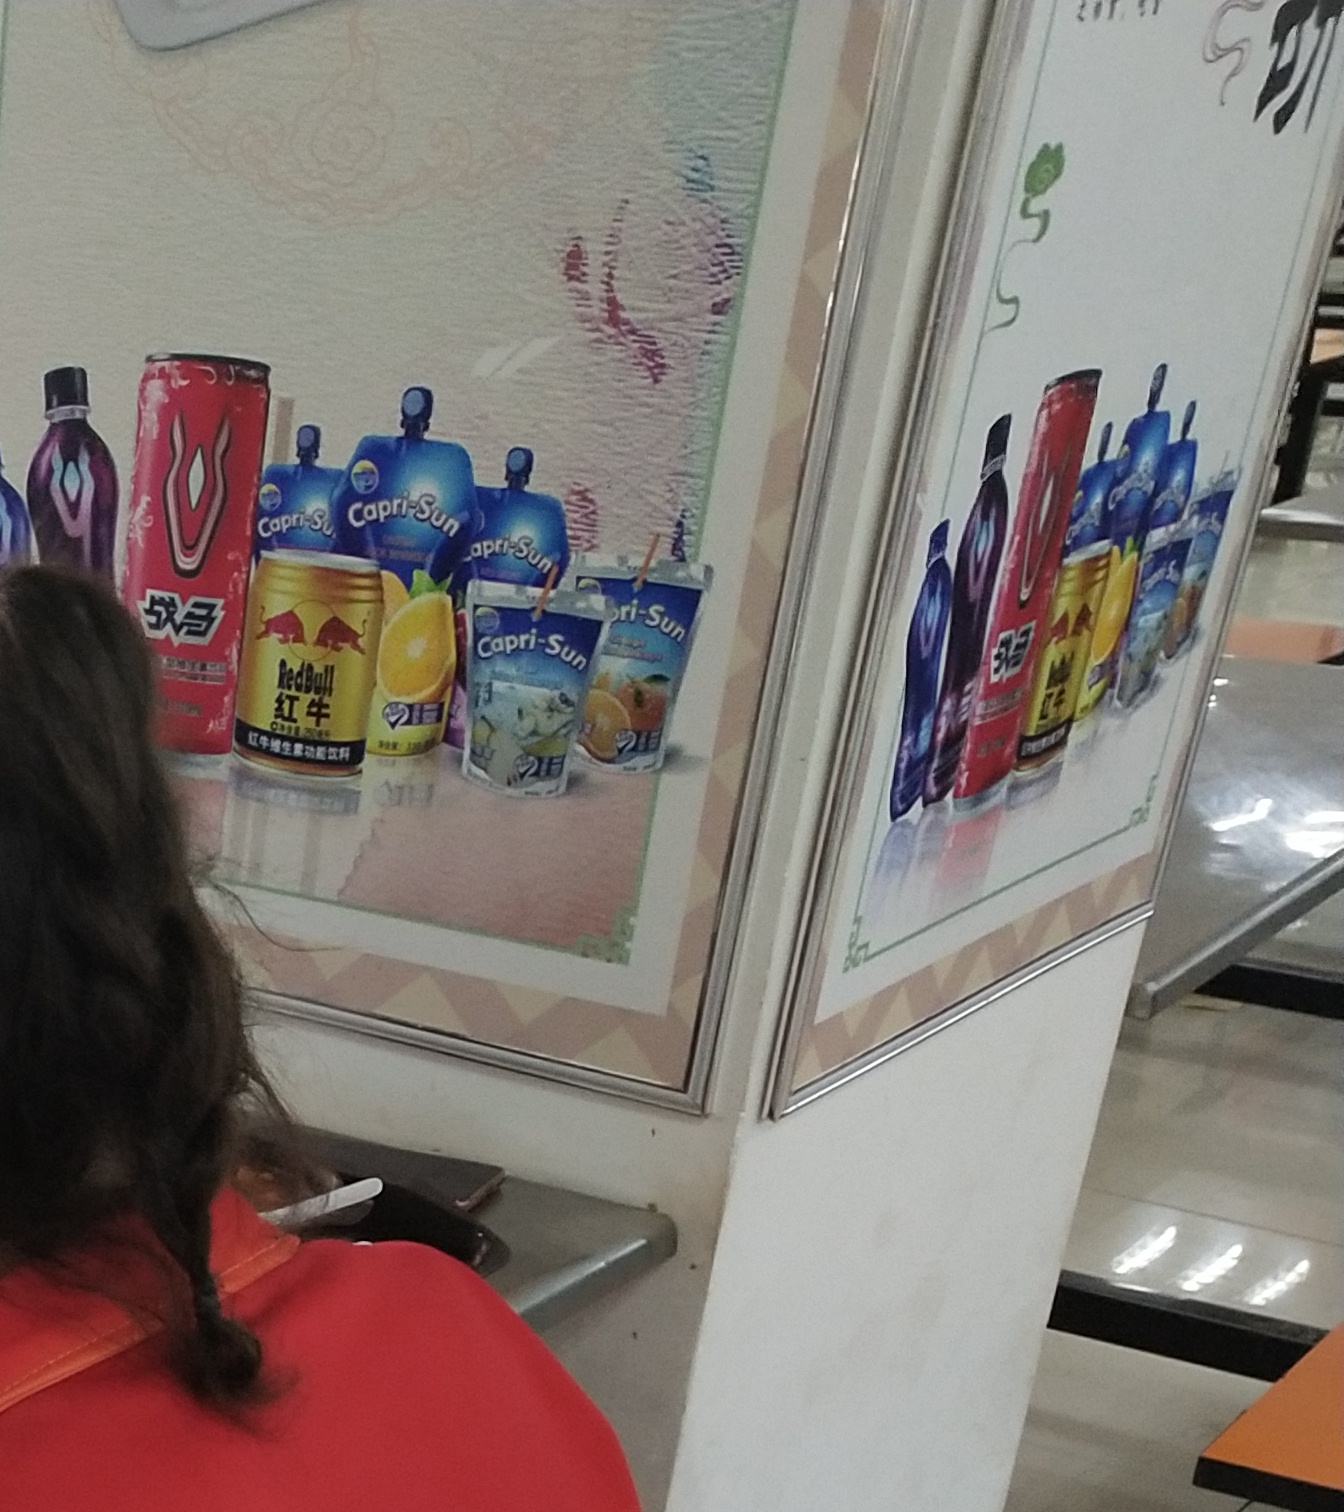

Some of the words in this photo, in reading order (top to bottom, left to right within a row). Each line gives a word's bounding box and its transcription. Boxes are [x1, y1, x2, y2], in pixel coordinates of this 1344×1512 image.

[258, 509, 337, 538] Capri-Su
[347, 494, 460, 538] Capri-Sun
[462, 537, 553, 574] apri-Sun
[610, 599, 685, 642] ri-Sun
[477, 629, 588, 671] Capri-Sun
[277, 658, 335, 697] RedBull
[273, 692, 331, 727] 红牛
[247, 730, 350, 762] 红牛维生素功能饮料
